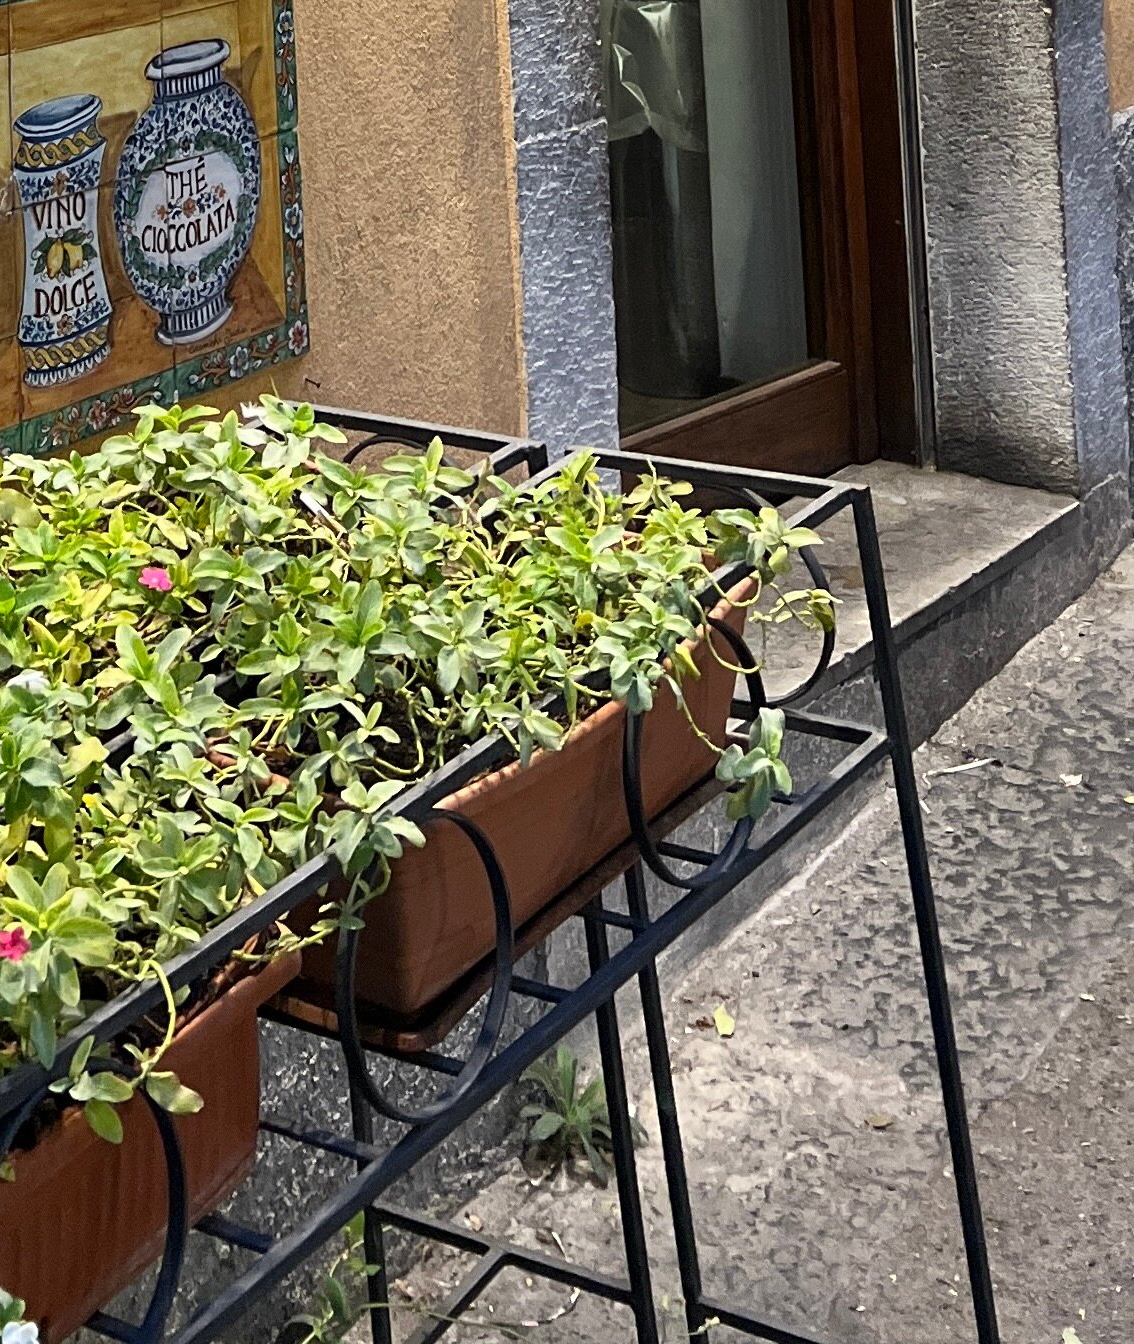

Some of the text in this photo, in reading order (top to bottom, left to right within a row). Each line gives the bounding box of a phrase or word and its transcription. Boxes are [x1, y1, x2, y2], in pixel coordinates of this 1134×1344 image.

[165, 157, 208, 200] THÉ
[31, 190, 87, 231] VINO
[141, 208, 237, 255] CIOCCOLATA
[34, 270, 100, 319] DOLCE
